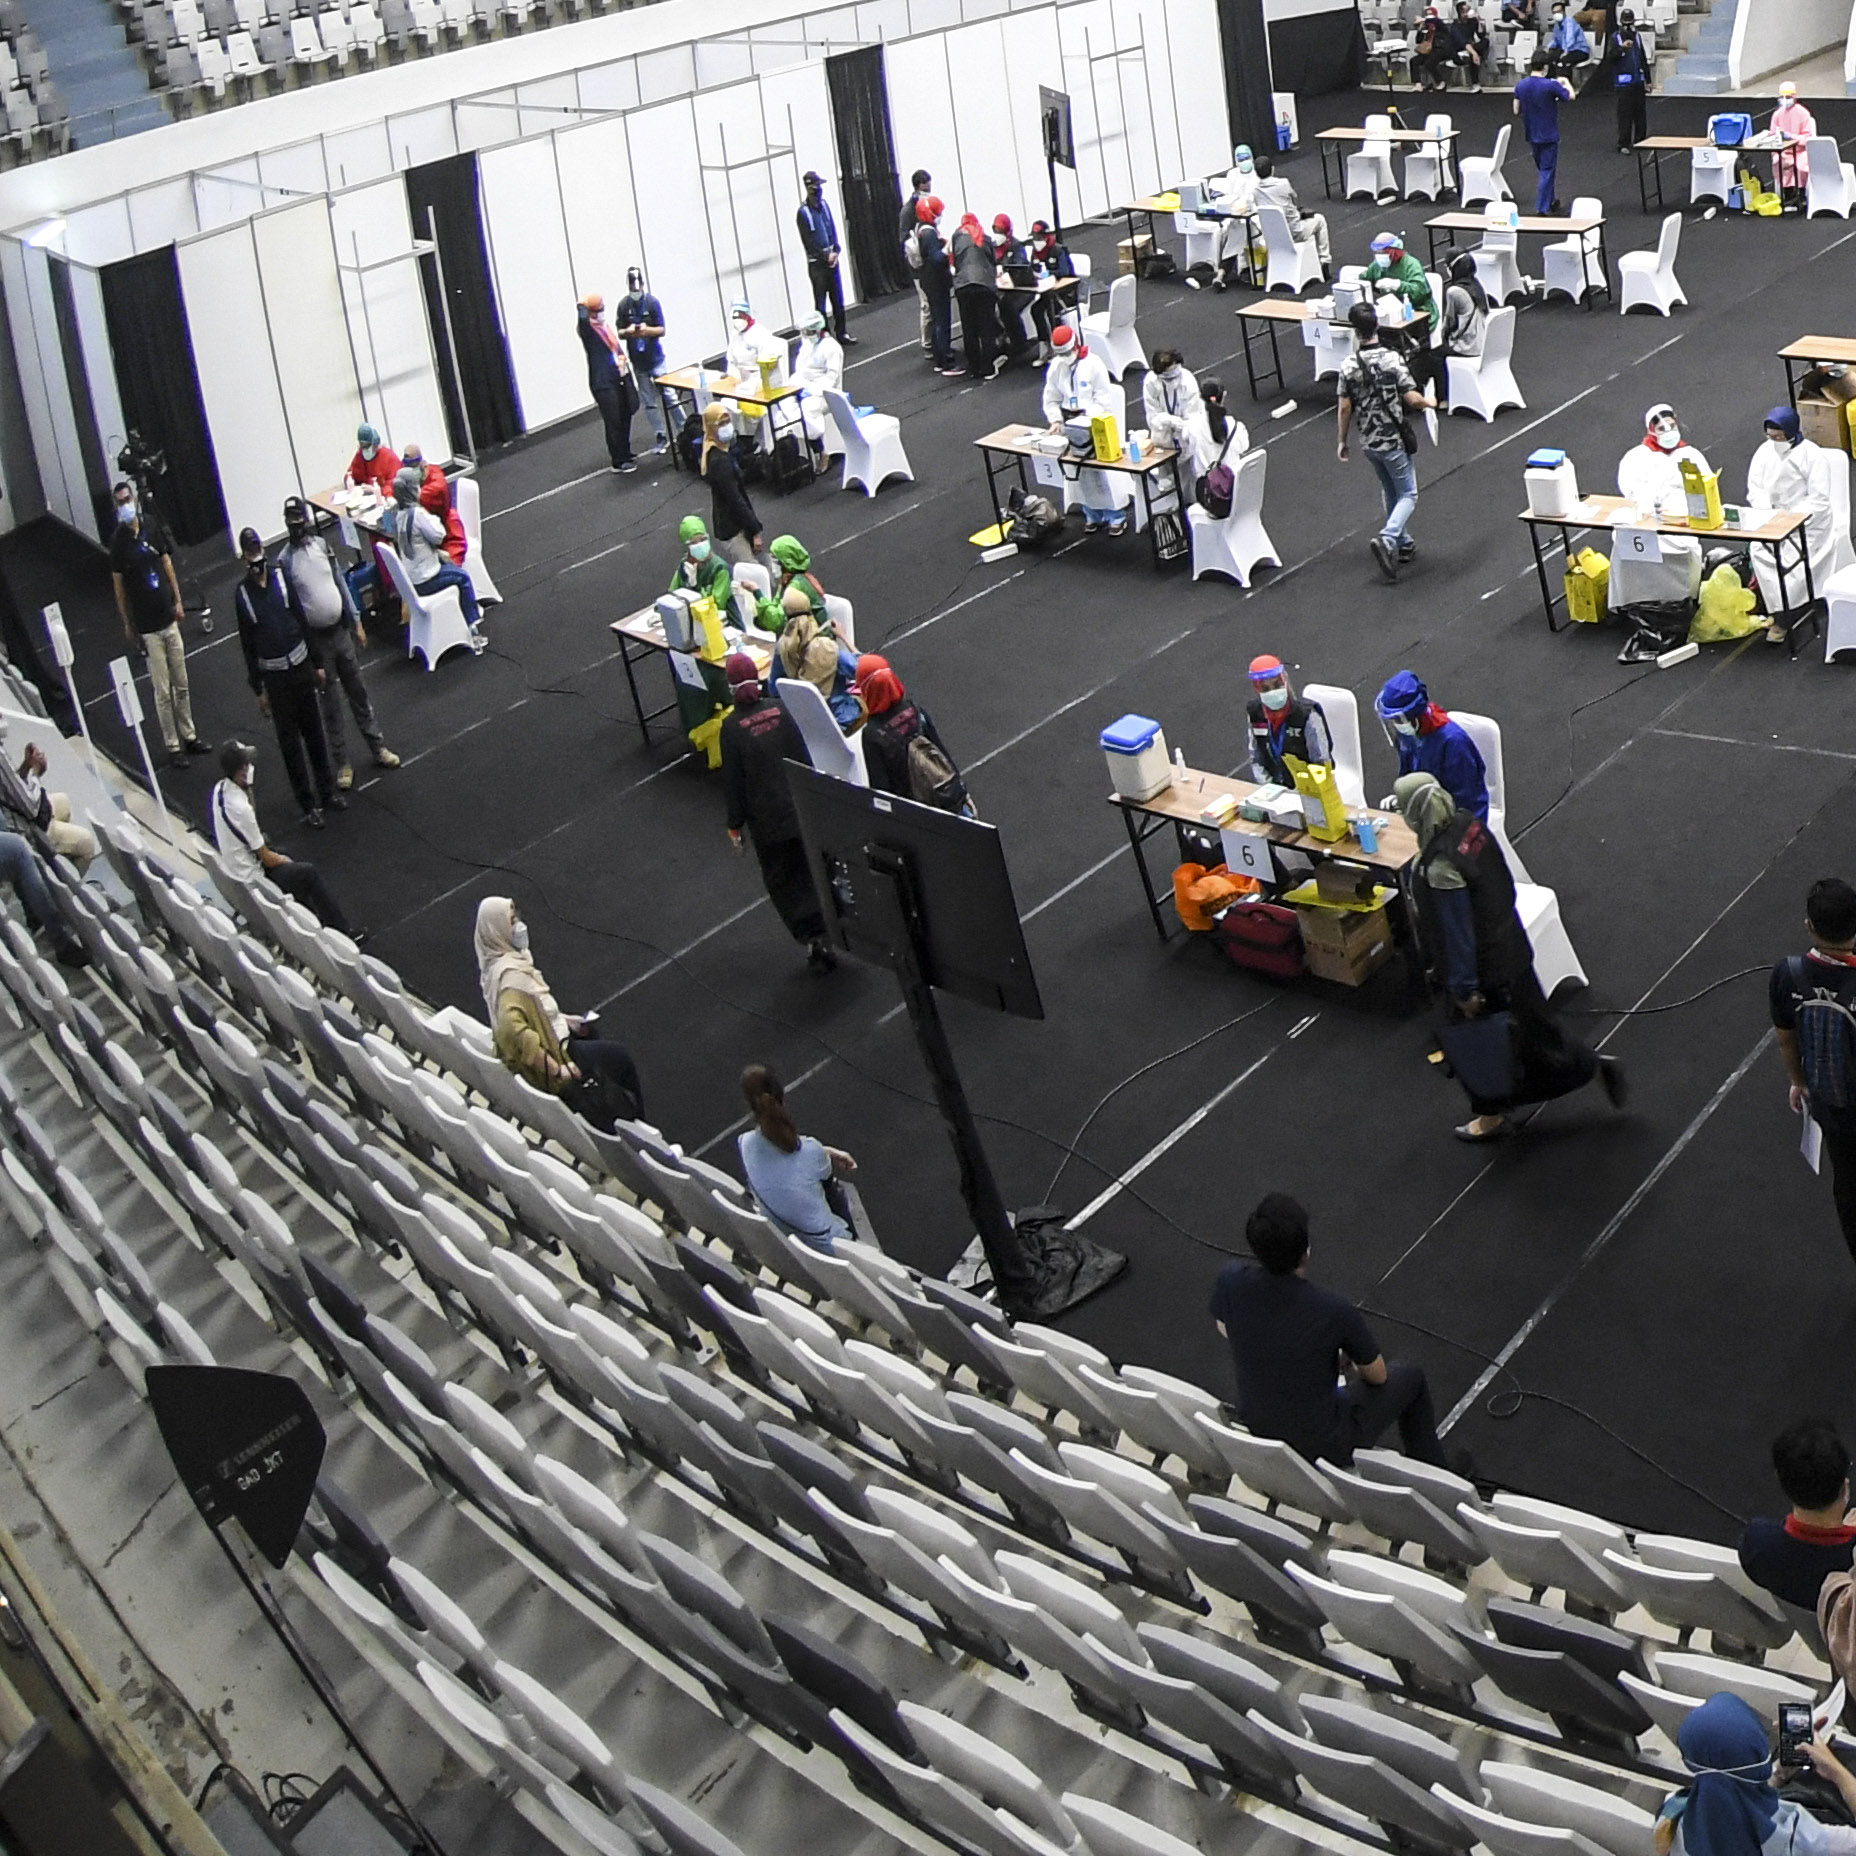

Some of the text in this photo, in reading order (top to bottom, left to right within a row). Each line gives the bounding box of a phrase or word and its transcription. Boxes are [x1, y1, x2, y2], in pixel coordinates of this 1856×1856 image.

[1703, 152, 1710, 163] 5
[1633, 536, 1645, 553] 6
[1242, 845, 1255, 867] 6
